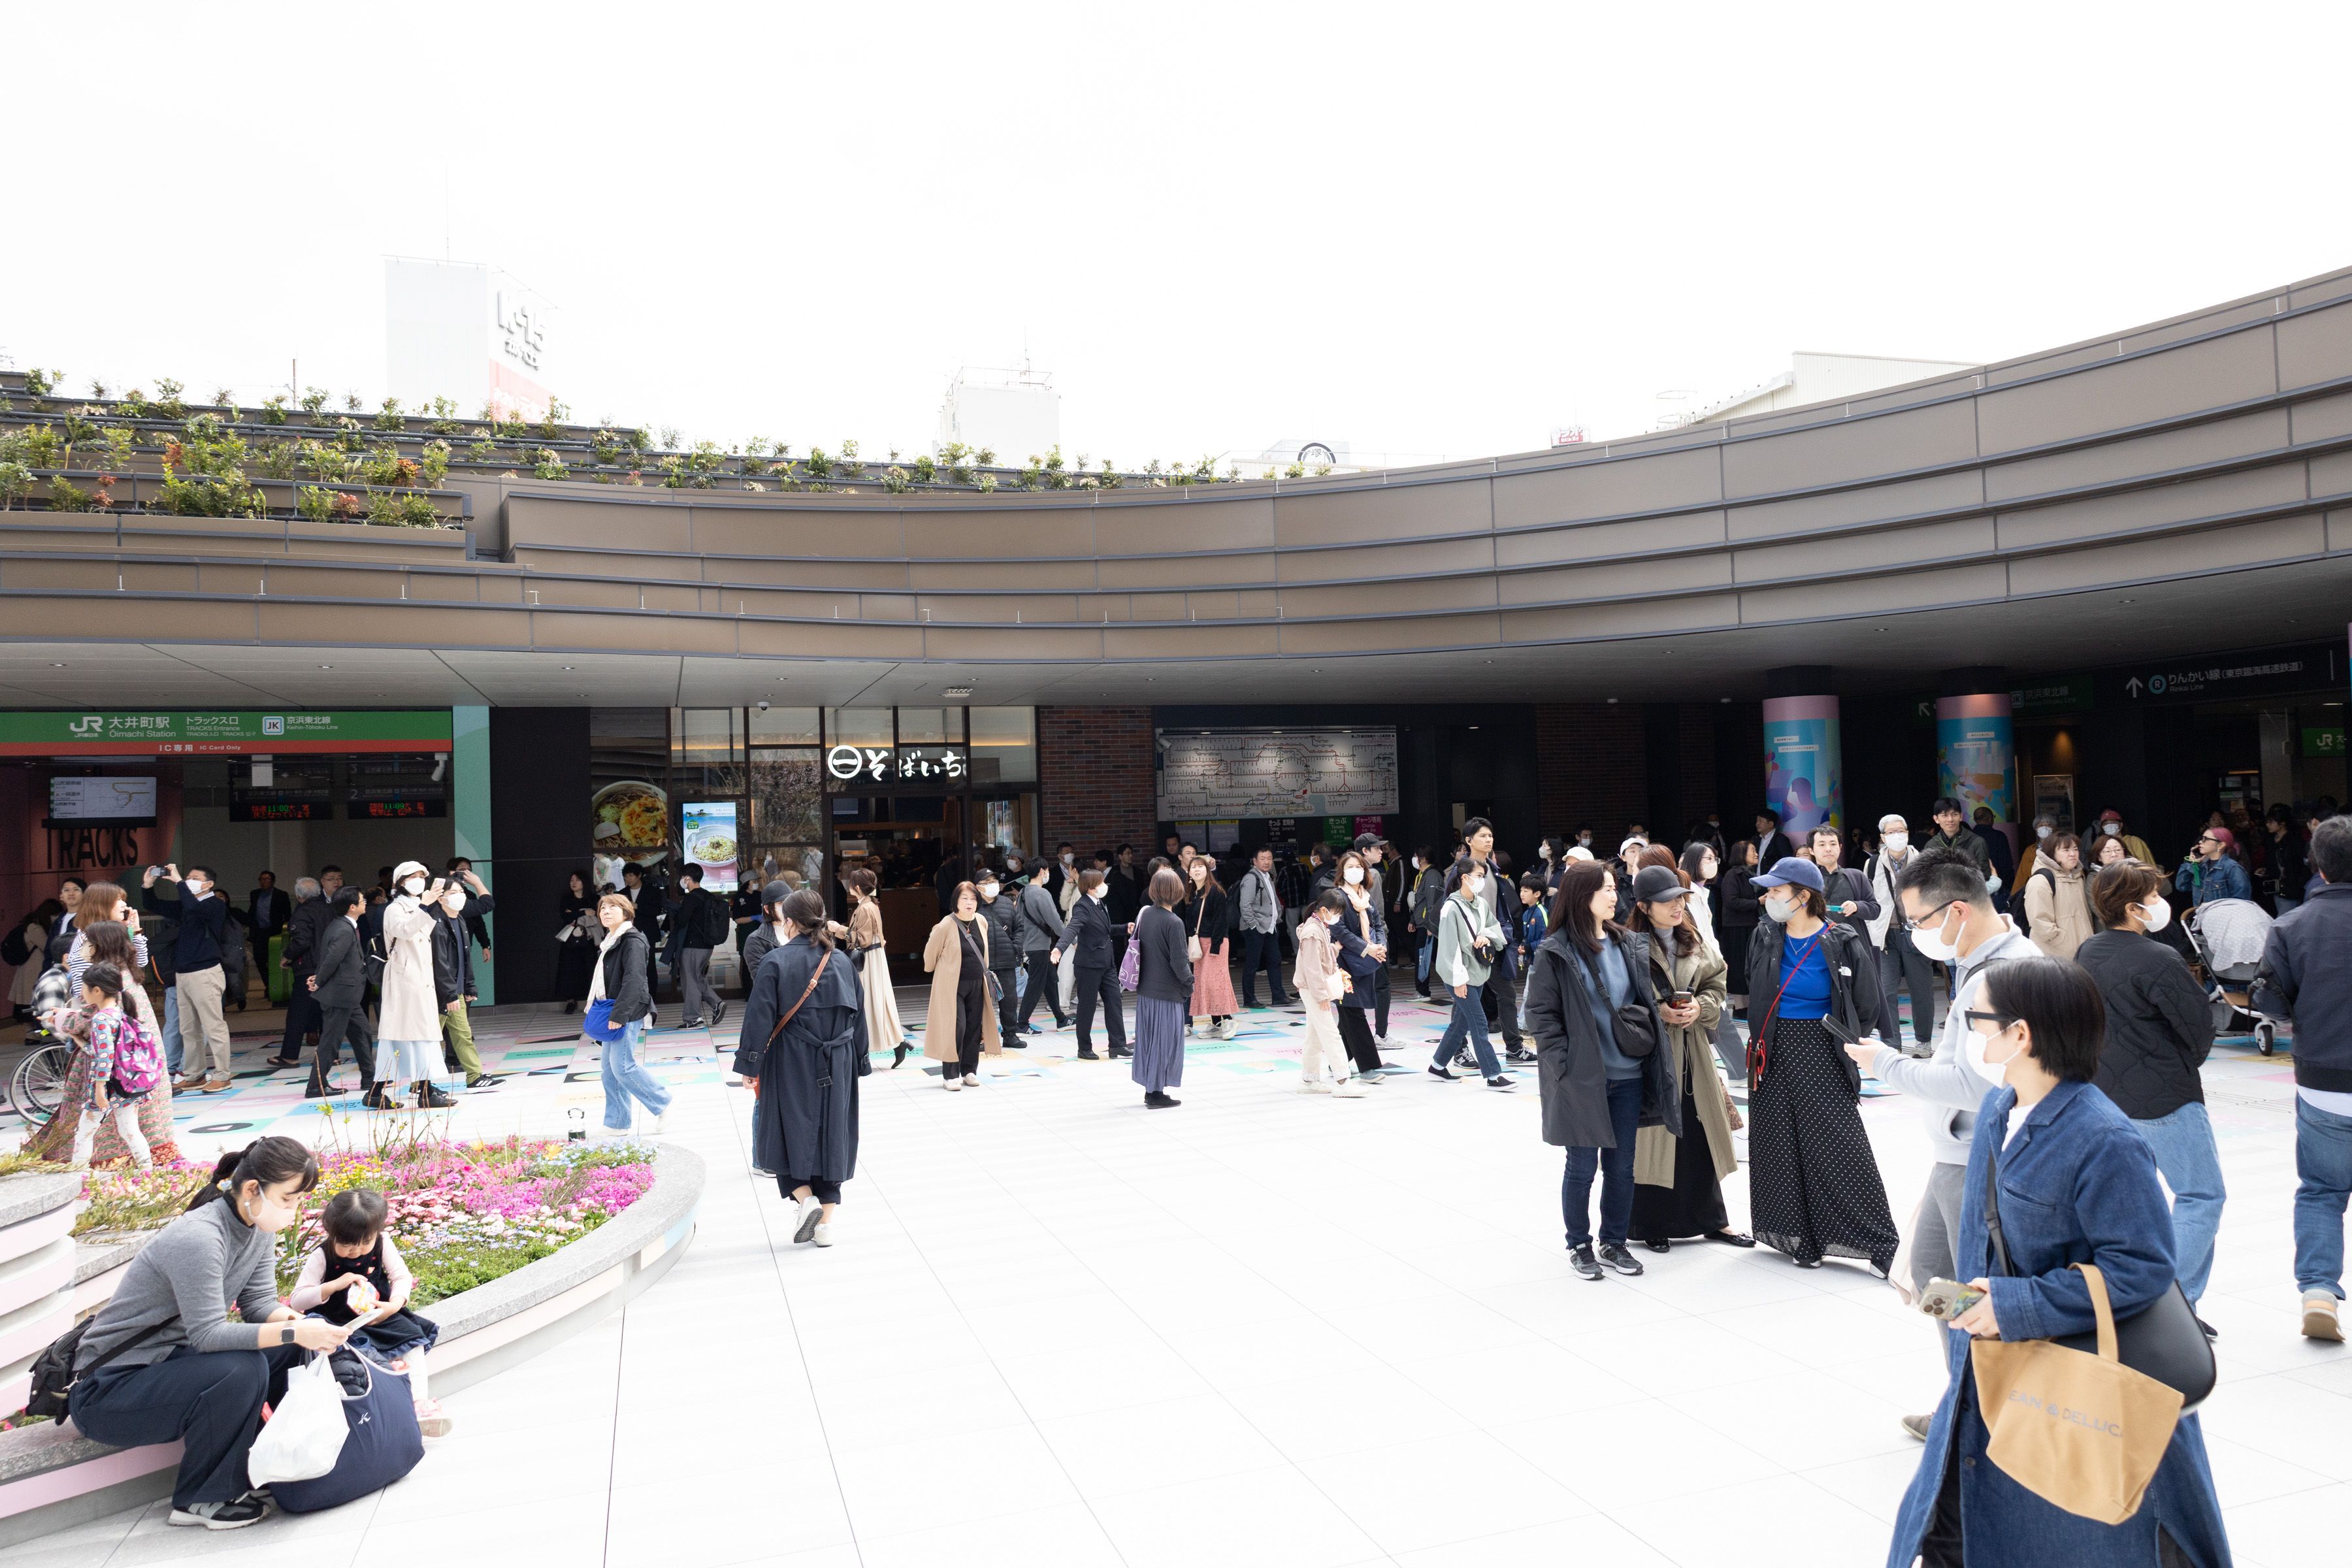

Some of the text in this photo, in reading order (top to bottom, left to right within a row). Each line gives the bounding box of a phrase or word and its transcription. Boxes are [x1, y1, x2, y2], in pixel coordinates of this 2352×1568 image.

[2026, 686, 2069, 700] 京浜東北線
[70, 716, 103, 732] JR
[108, 716, 170, 729] 大井町駅
[186, 716, 238, 725] トラックス口
[267, 721, 279, 730] JK
[286, 716, 331, 725] 京浜東北線
[2316, 734, 2333, 746] JR
[865, 749, 962, 781] そばいち
[350, 789, 358, 800] 2
[42, 820, 138, 868] TRACKS
[2008, 1390, 2122, 1438] EAN & DELUC
